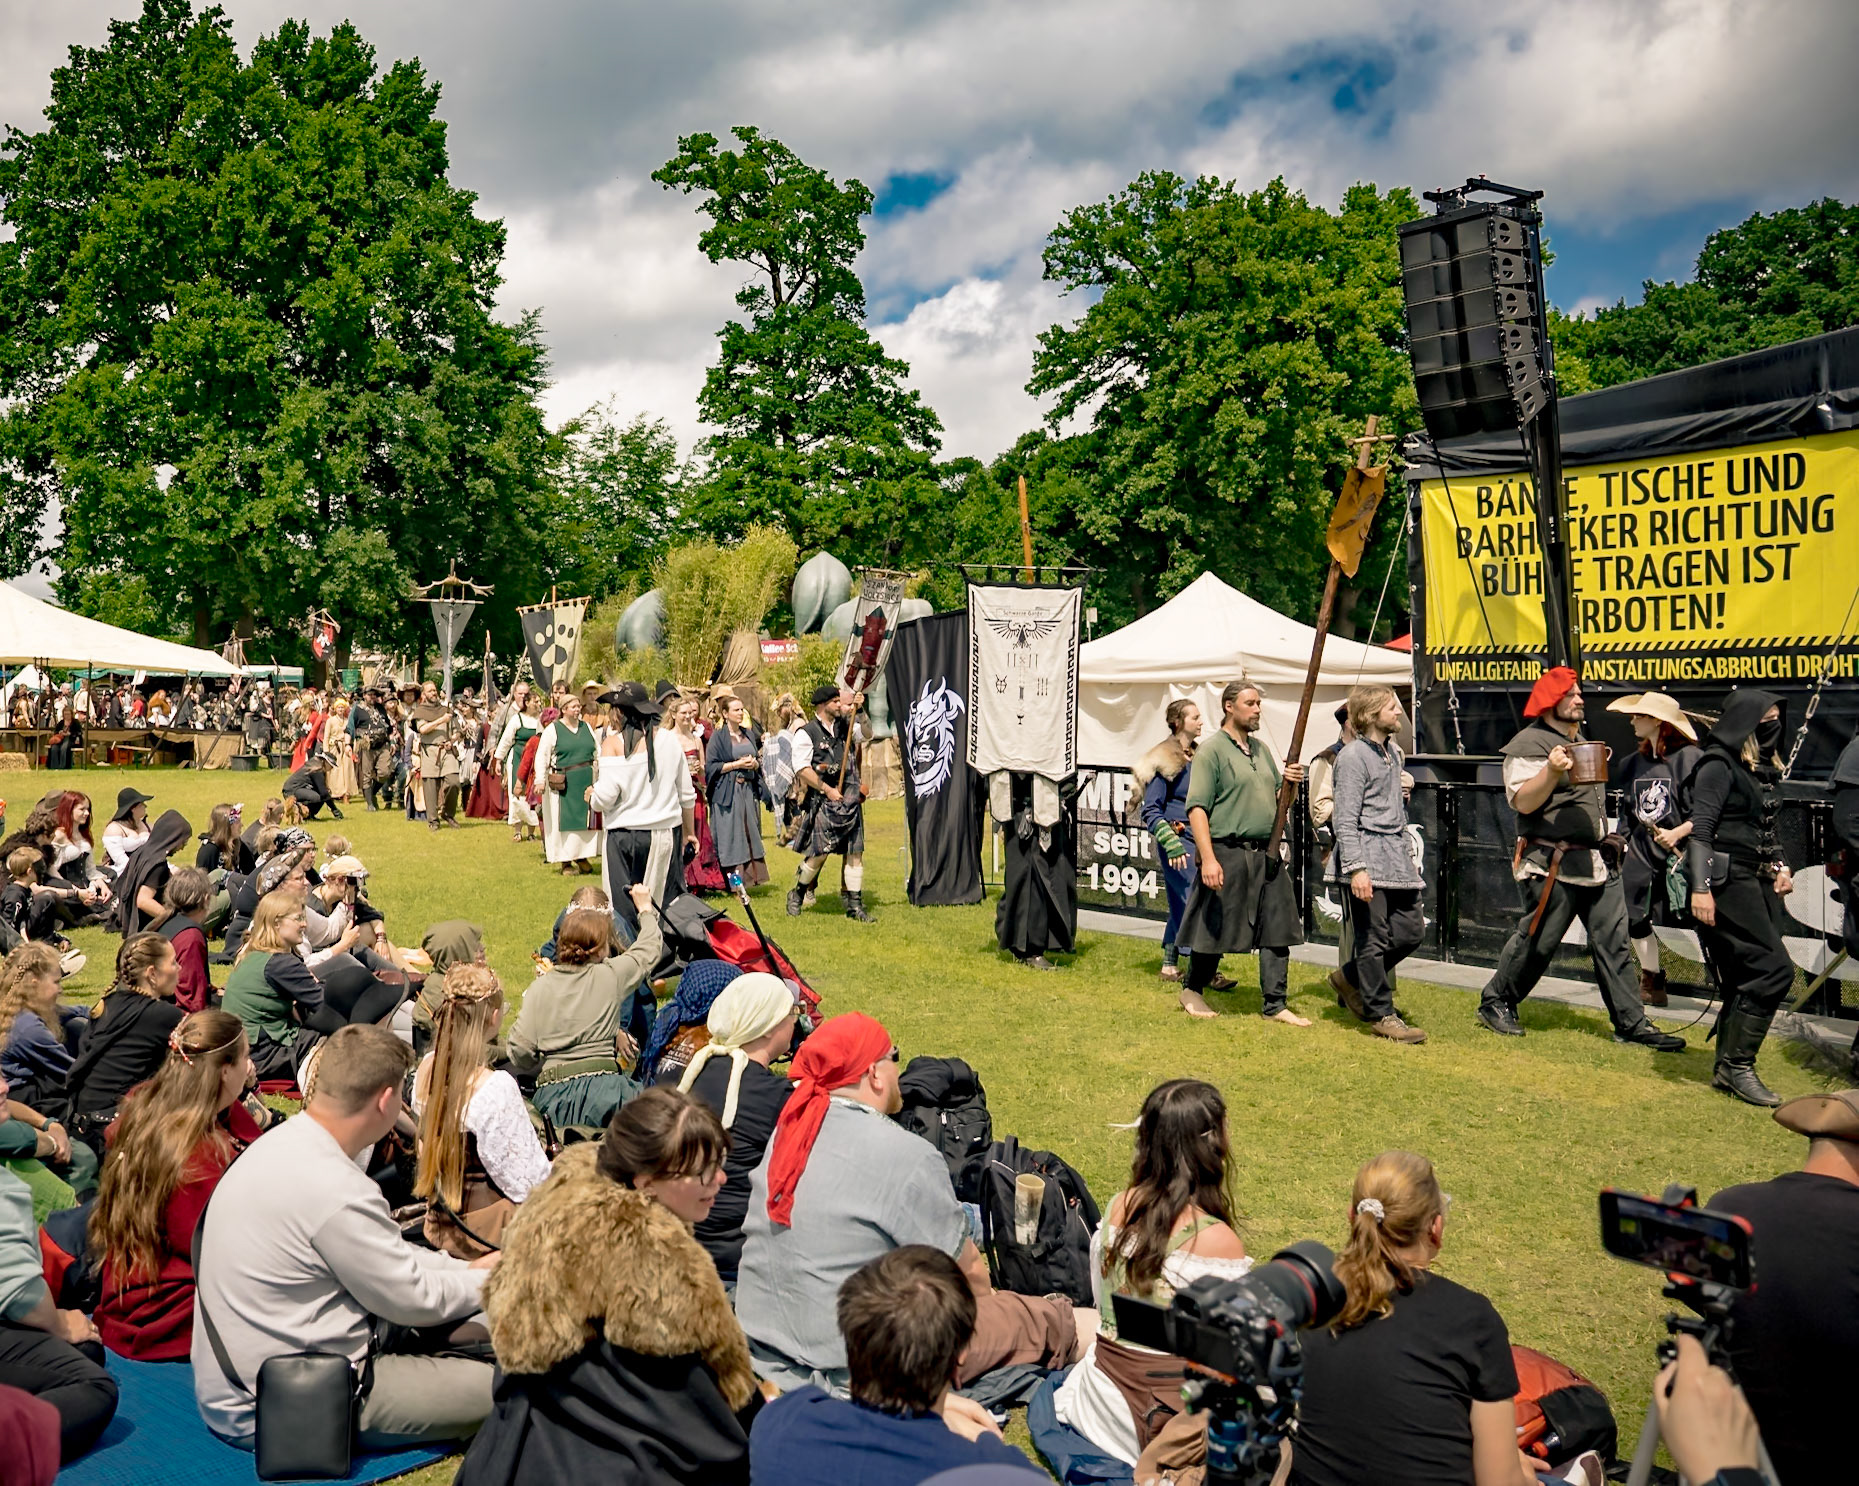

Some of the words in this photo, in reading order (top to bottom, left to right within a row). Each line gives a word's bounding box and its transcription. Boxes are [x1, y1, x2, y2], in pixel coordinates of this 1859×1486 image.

[1477, 477, 1588, 518] BÄNE,
[1598, 461, 1715, 508] TISCHE
[1726, 452, 1806, 496] UND
[1456, 513, 1639, 559] BARHKER
[1649, 494, 1835, 546] RICHTUNG
[1482, 557, 1583, 597] BÜHE
[1592, 547, 1730, 591] TRAGEN
[1742, 542, 1801, 584] IST
[1541, 592, 1726, 634] RBOTEN!
[1581, 655, 1792, 681] ANSTALTUNGSABBRUCH
[1093, 827, 1152, 859] seit
[1086, 862, 1159, 899] 1994
